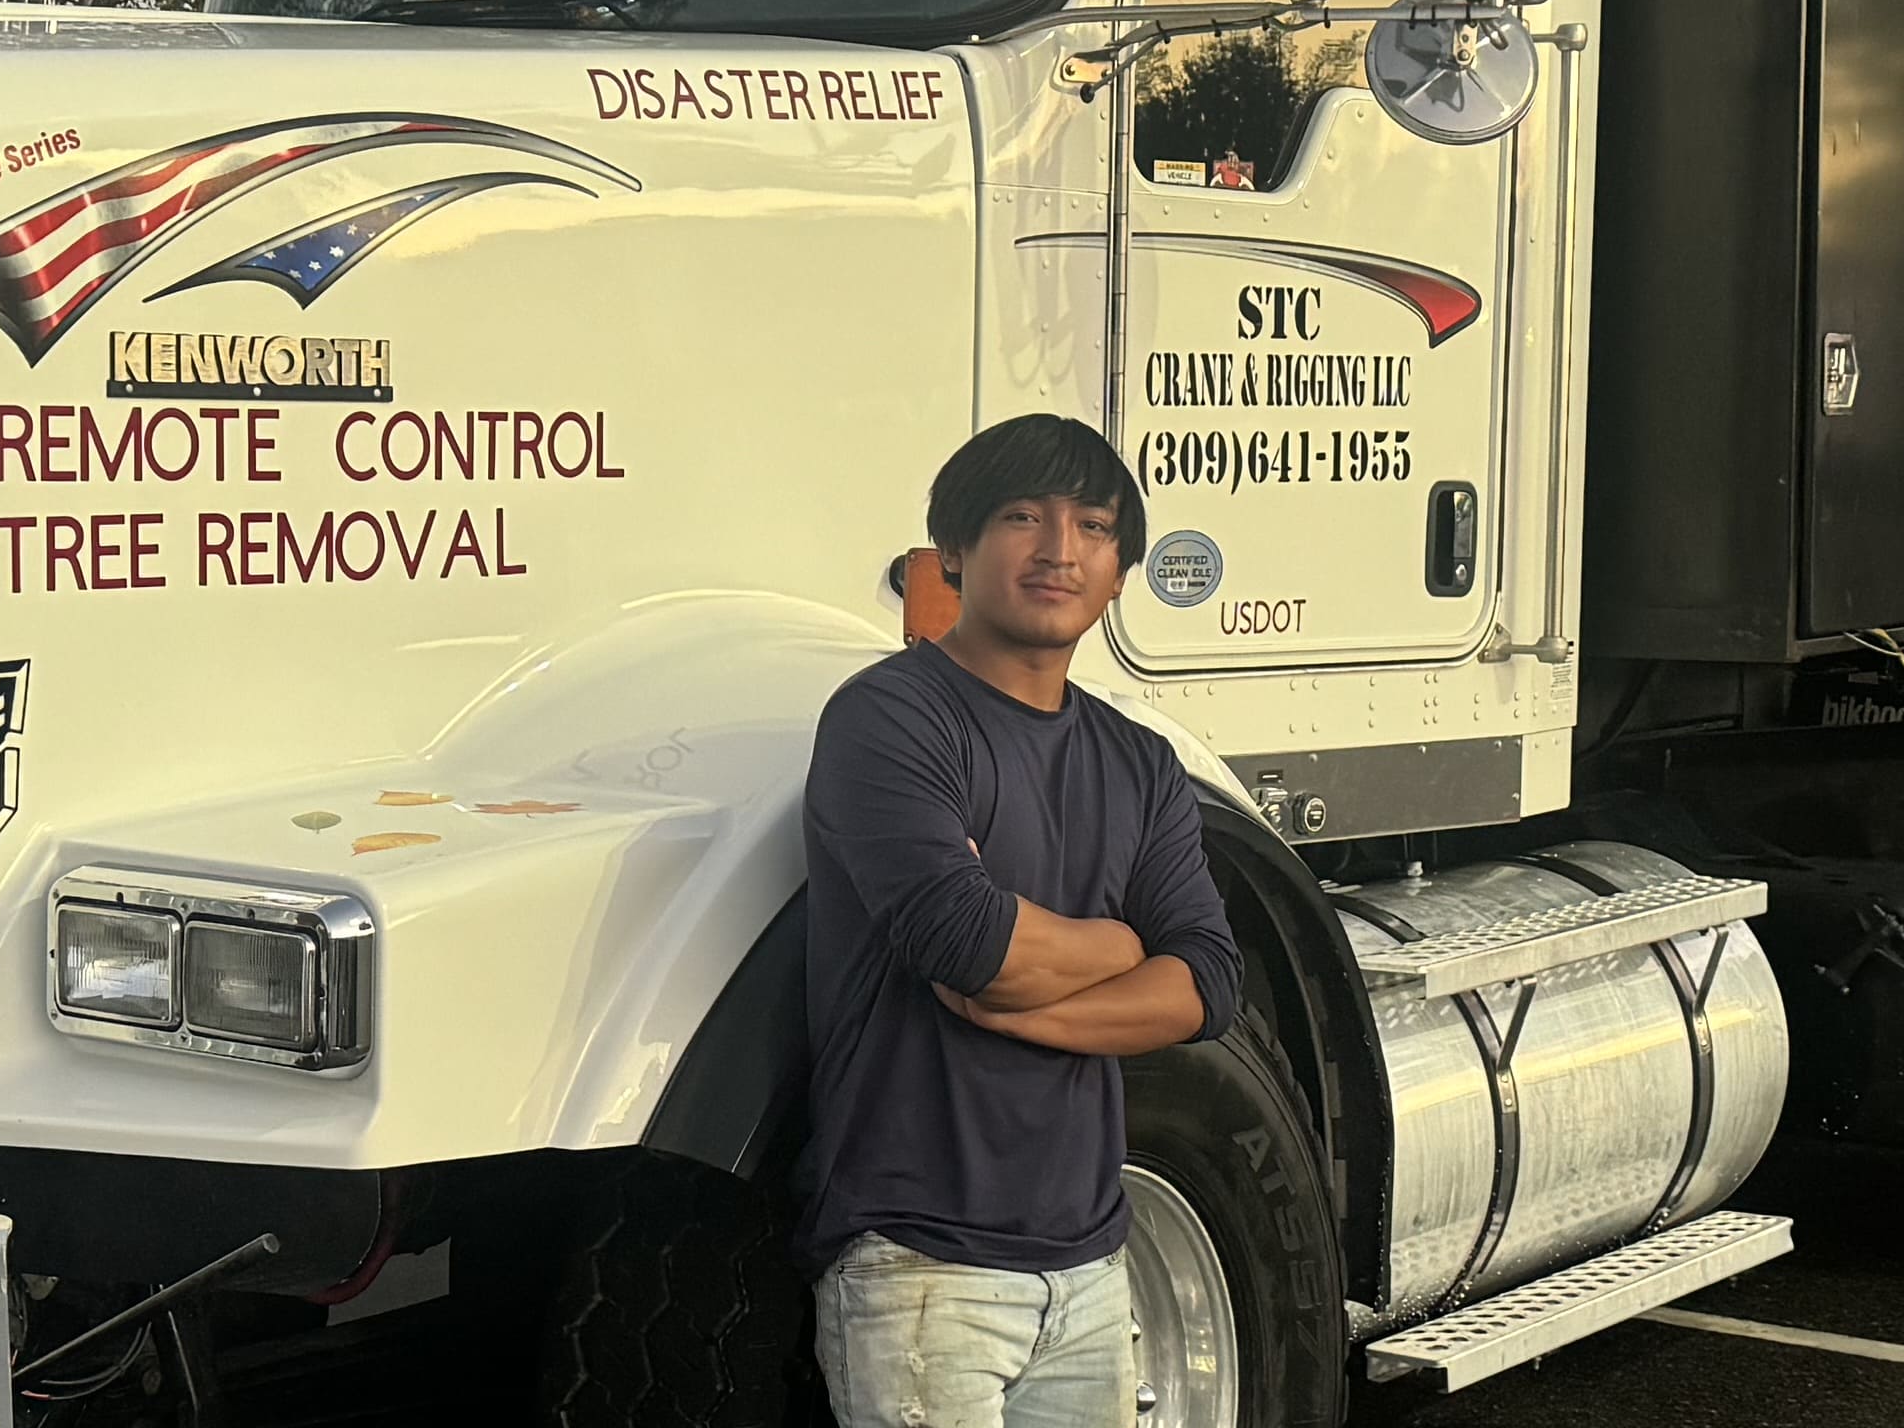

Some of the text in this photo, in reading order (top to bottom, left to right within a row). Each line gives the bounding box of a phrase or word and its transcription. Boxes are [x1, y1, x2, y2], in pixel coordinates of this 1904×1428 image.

[586, 69, 944, 121] DISASTER RELIEF
[3, 128, 82, 173] Series
[1237, 285, 1321, 341] STC
[109, 331, 391, 388] KENWORTH
[1145, 351, 1411, 407] CRANE & RIGGING LLC
[335, 411, 625, 481] CONTROL
[1137, 430, 1412, 498] (309)641-1955
[198, 507, 527, 587] REMOVAL
[1156, 567, 1213, 579] CLEAN IDLE
[1162, 555, 1208, 566] CERTIFIED
[1220, 598, 1307, 635] USDOT
